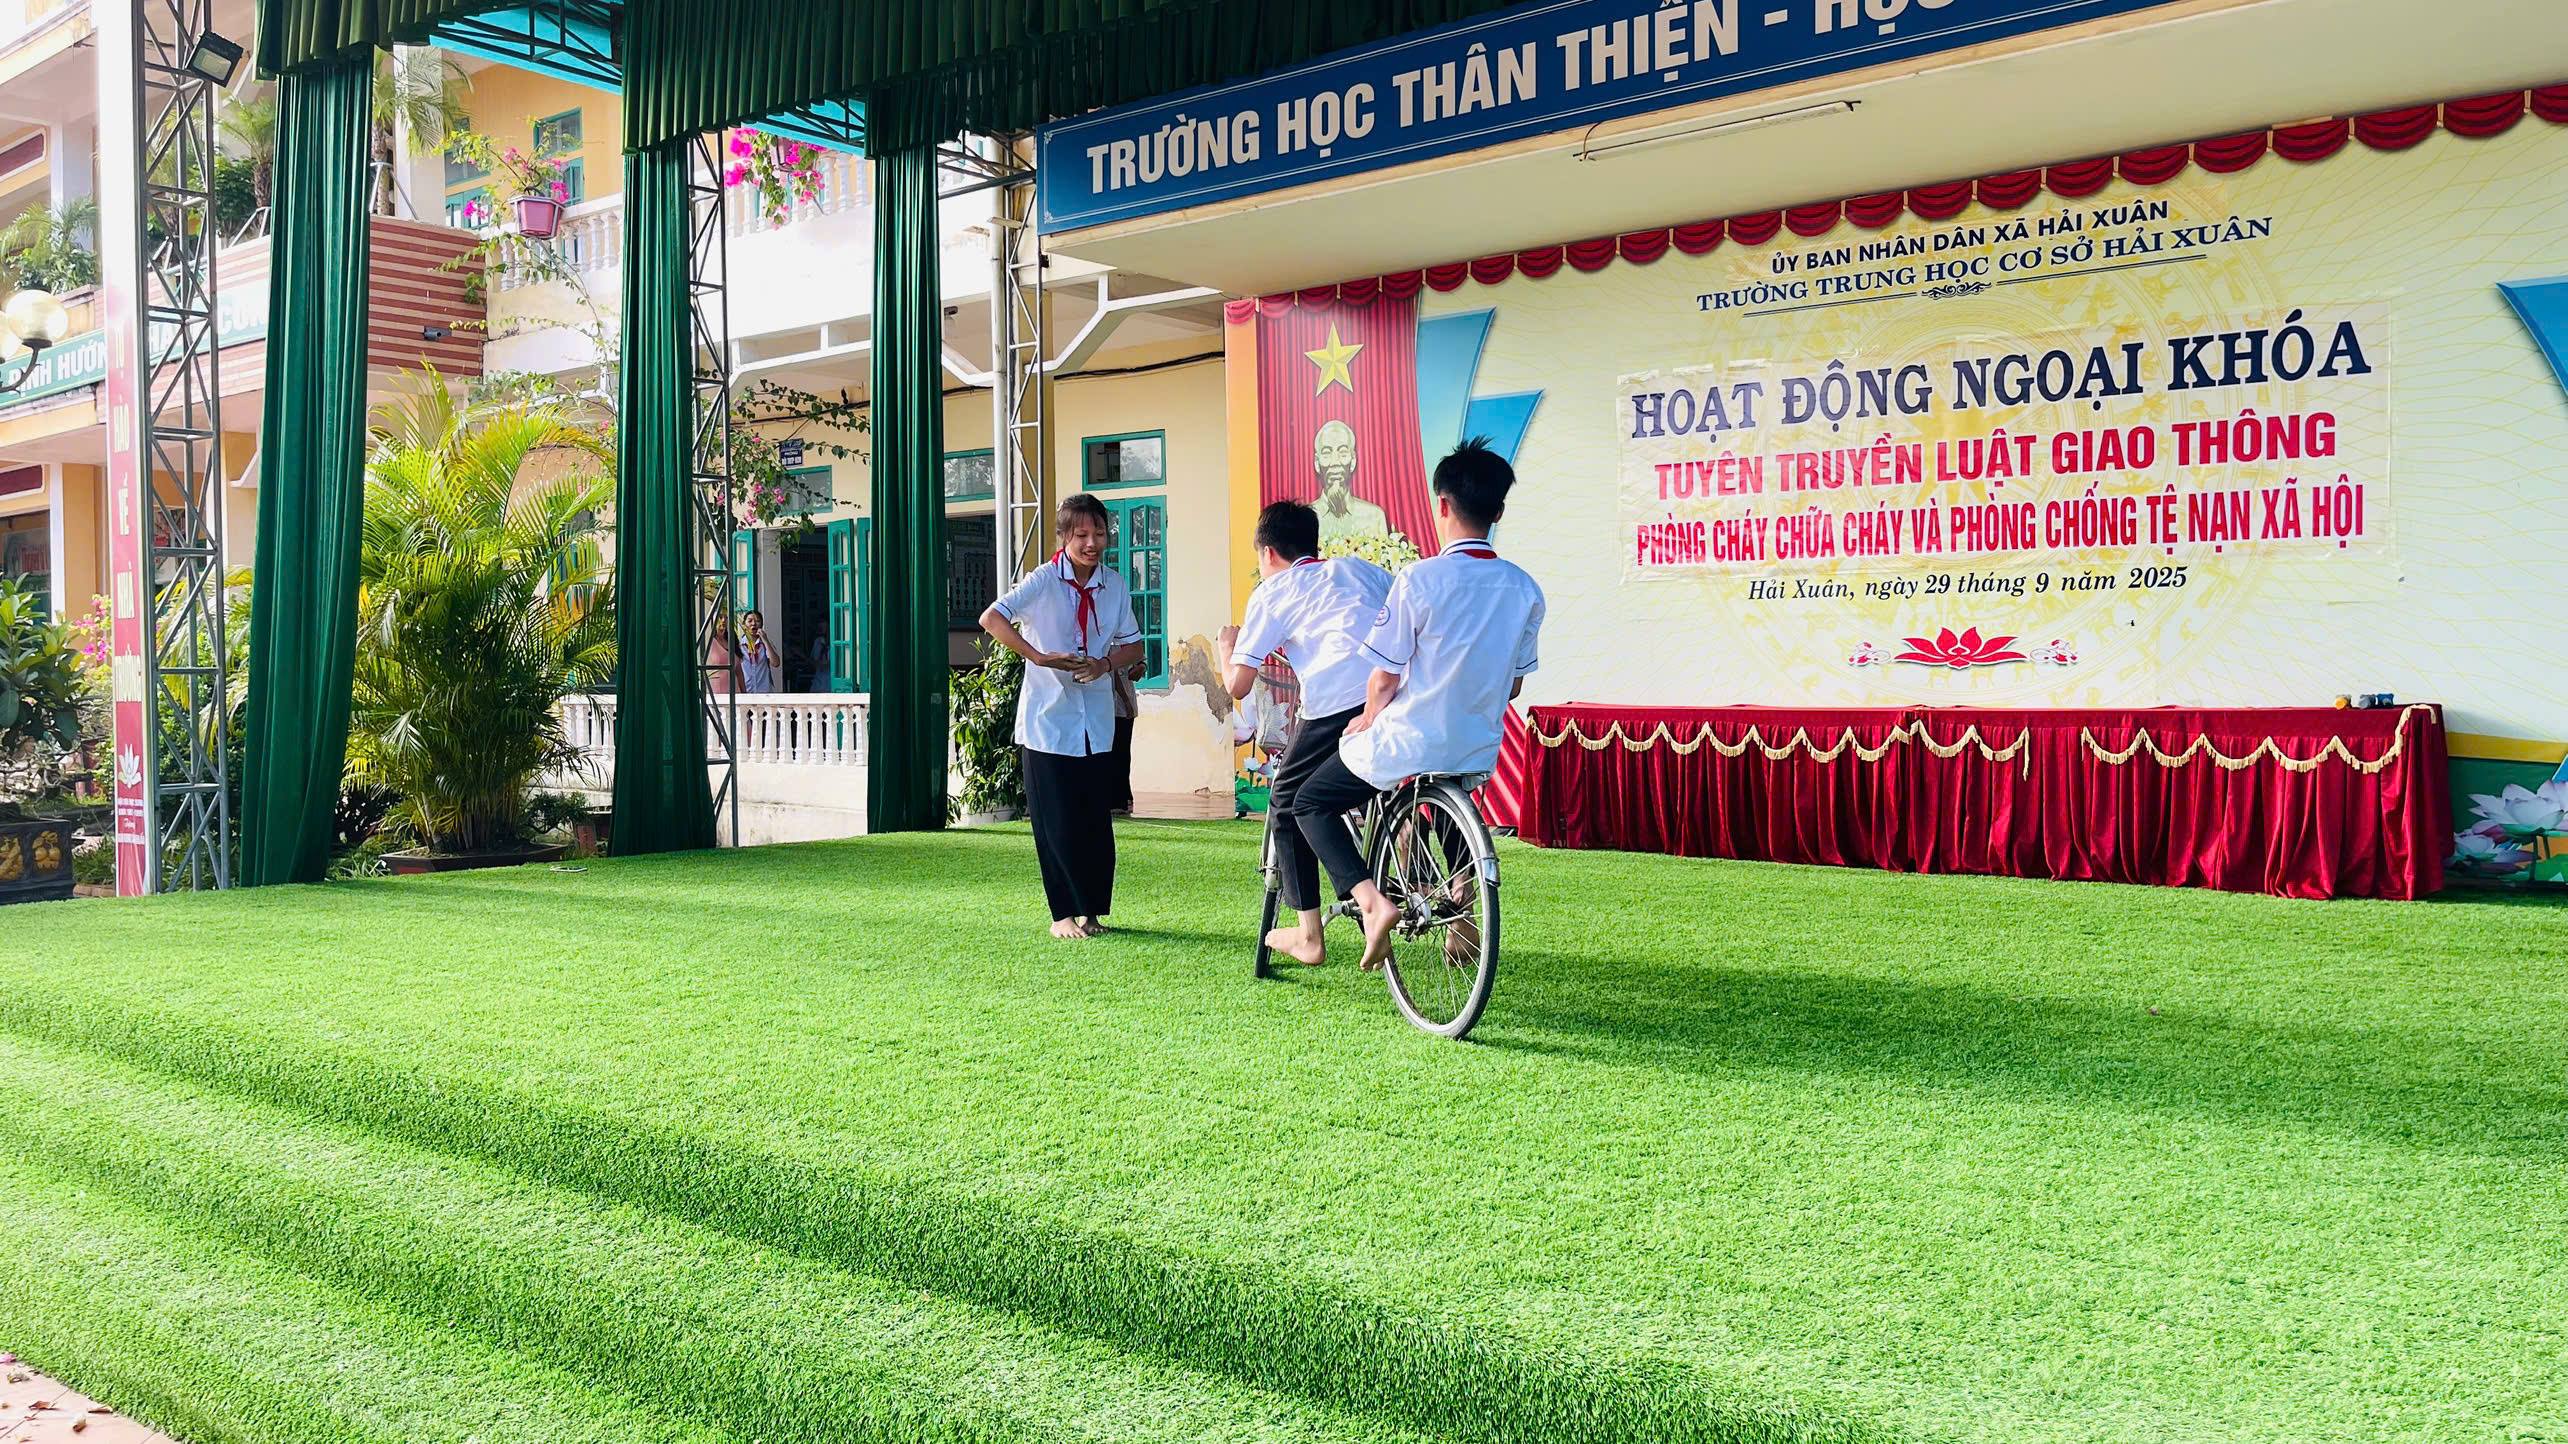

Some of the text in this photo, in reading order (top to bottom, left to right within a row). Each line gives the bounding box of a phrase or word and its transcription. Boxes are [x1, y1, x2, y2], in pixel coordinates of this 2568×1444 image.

[1087, 111, 1260, 193] TRƯỜNG
[1278, 84, 1375, 157] HỌC
[1393, 42, 1537, 127] THÂN
[1557, 0, 1739, 91] THIỆN
[1697, 216, 2272, 311] TRƯỜNG TRUNG HỌC CƠ SỞ HẢI XUÂN
[1773, 199, 2168, 274] ỦY BAN NHÂN DÂN XÃ HẢI XUÂN
[1632, 309, 2372, 443] HOẠT ĐỘNG NGOẠI KHÓA
[1655, 408, 2336, 500] TUYÊN TRUYỀN LUẬT GIAO THÔNG
[1638, 474, 2363, 566] PHÒNG CHÁY CHỮA CHÁY VÀ PHÒNG CHỐNG TỆ NẠN XÃ HỘI
[1748, 565, 2188, 601] Hải Xuân, ngày 29 tháng 9 năm 2025
